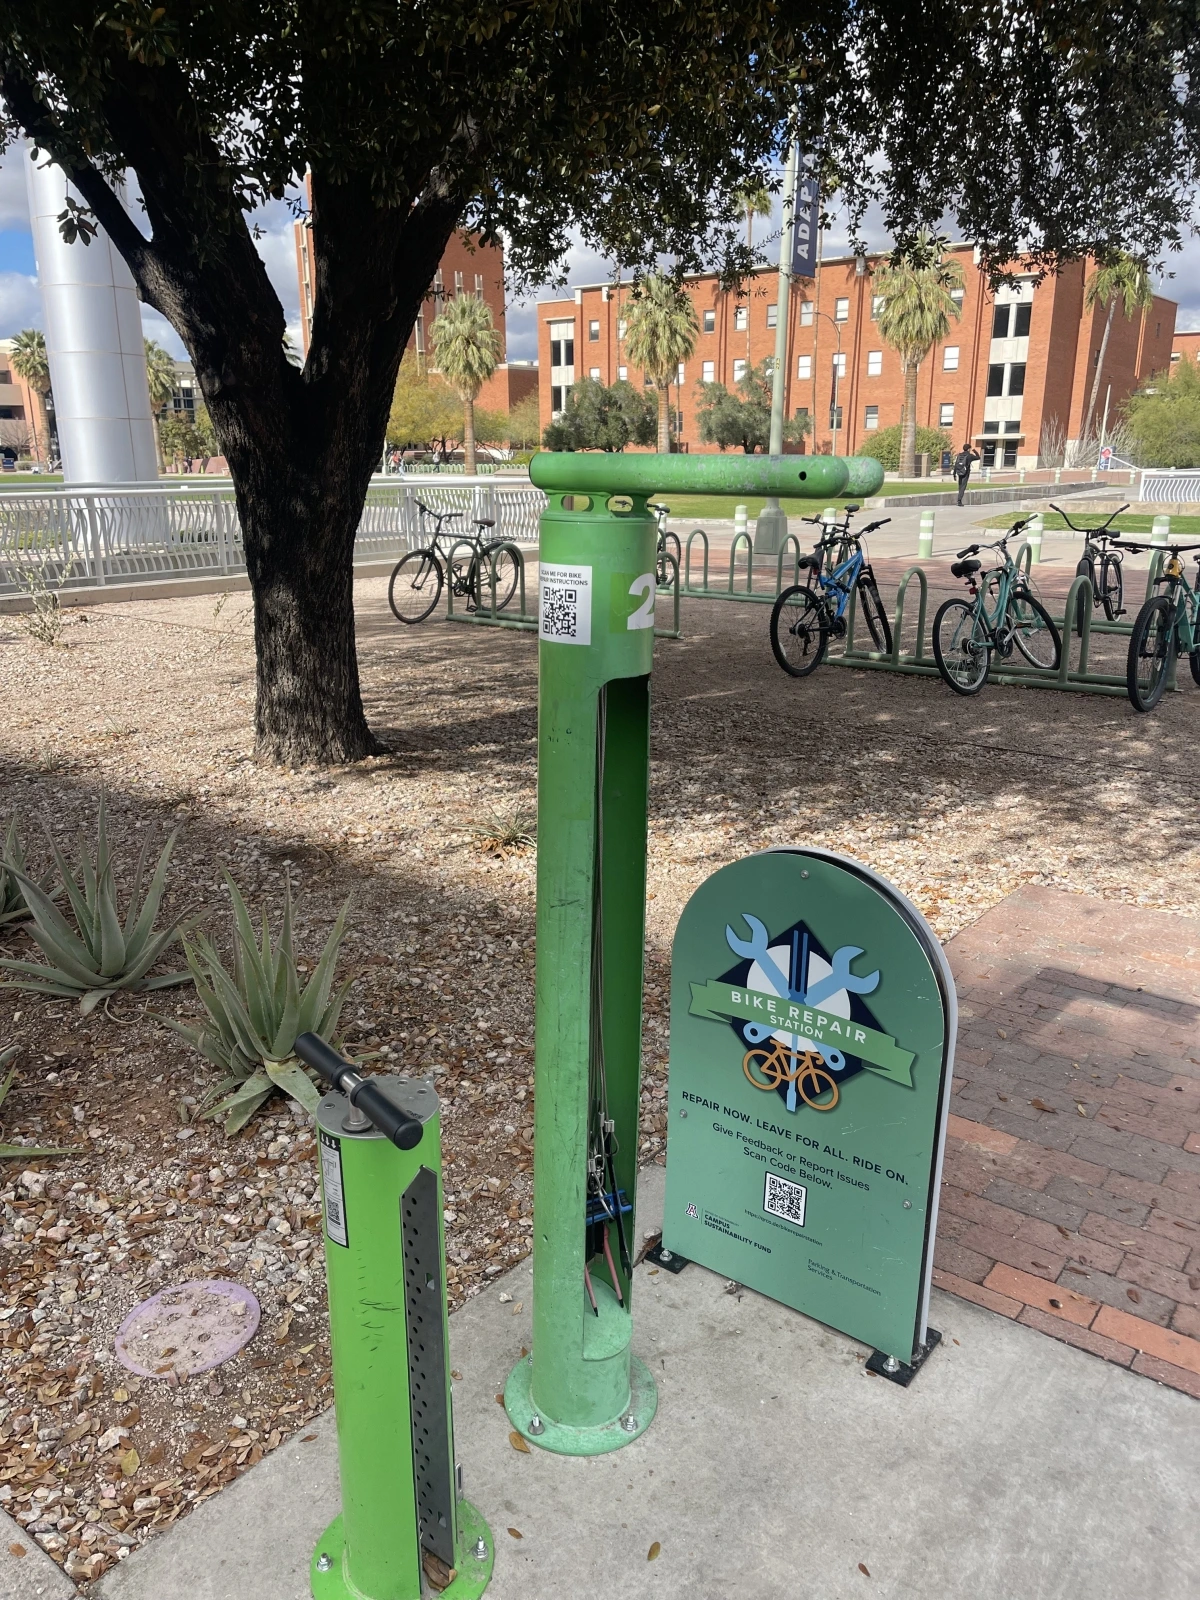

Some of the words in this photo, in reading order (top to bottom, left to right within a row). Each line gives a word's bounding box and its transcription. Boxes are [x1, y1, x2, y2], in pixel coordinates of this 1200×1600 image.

[550, 577, 589, 586] INSTRUCTIONS
[626, 572, 656, 631] 2
[731, 990, 777, 1013] BIKE
[789, 1005, 867, 1045] REPAIR
[769, 1015, 824, 1040] STATION
[682, 1090, 720, 1112] REPAIR
[723, 1106, 753, 1125] NOW.
[756, 1118, 792, 1140] LEAVE
[795, 1133, 820, 1150] FOR
[823, 1145, 849, 1162] ALL.
[852, 1155, 882, 1174] RIDE
[885, 1168, 909, 1186] ON.
[712, 1122, 734, 1137] Give
[736, 1131, 783, 1157] Feedback
[786, 1152, 797, 1162] or
[799, 1156, 835, 1177] Report
[837, 1170, 870, 1191] Issues
[743, 1146, 767, 1163] Scan
[769, 1157, 797, 1175] Code
[799, 1168, 833, 1190] Below.
[704, 1213, 730, 1229] CAMPUS
[704, 1220, 753, 1245] SUSTAINABILITY
[753, 1242, 772, 1254] FUND
[807, 1265, 833, 1281] Services
[808, 1258, 830, 1274] Parking
[836, 1271, 882, 1297] Transportation
